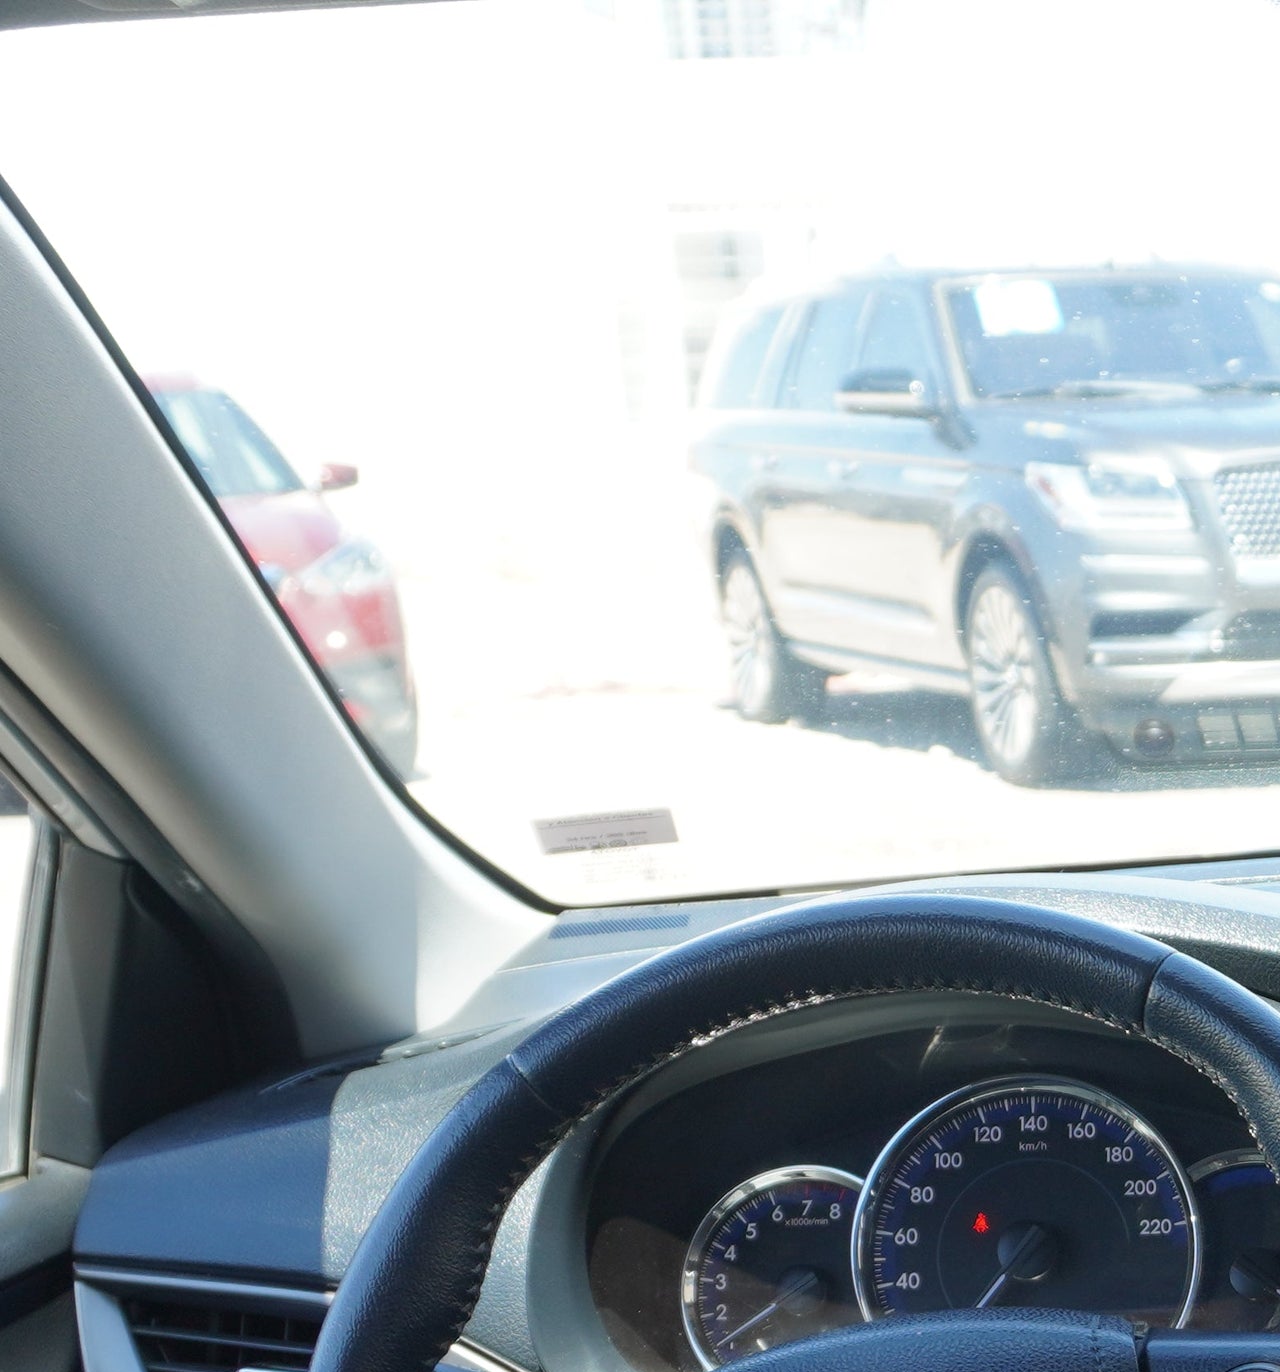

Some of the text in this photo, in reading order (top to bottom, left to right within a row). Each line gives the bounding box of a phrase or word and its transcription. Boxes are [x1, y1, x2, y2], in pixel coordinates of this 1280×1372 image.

[1019, 1115, 1048, 1132] 140
[1067, 1122, 1096, 1139] 160
[974, 1126, 1002, 1143] 120
[1018, 1140, 1047, 1151] km/h
[934, 1152, 963, 1168] 100
[1105, 1146, 1134, 1163] 180
[910, 1186, 934, 1203] 80
[1124, 1179, 1157, 1195] 200
[771, 1205, 784, 1222] 6
[802, 1199, 813, 1216] 7
[829, 1203, 841, 1220] 8
[745, 1223, 758, 1240] 5
[1139, 1219, 1172, 1235] 220
[894, 1228, 918, 1245] 60
[724, 1244, 737, 1262] 4
[715, 1273, 727, 1290] 3
[896, 1272, 920, 1289] 40
[715, 1303, 728, 1321] 2
